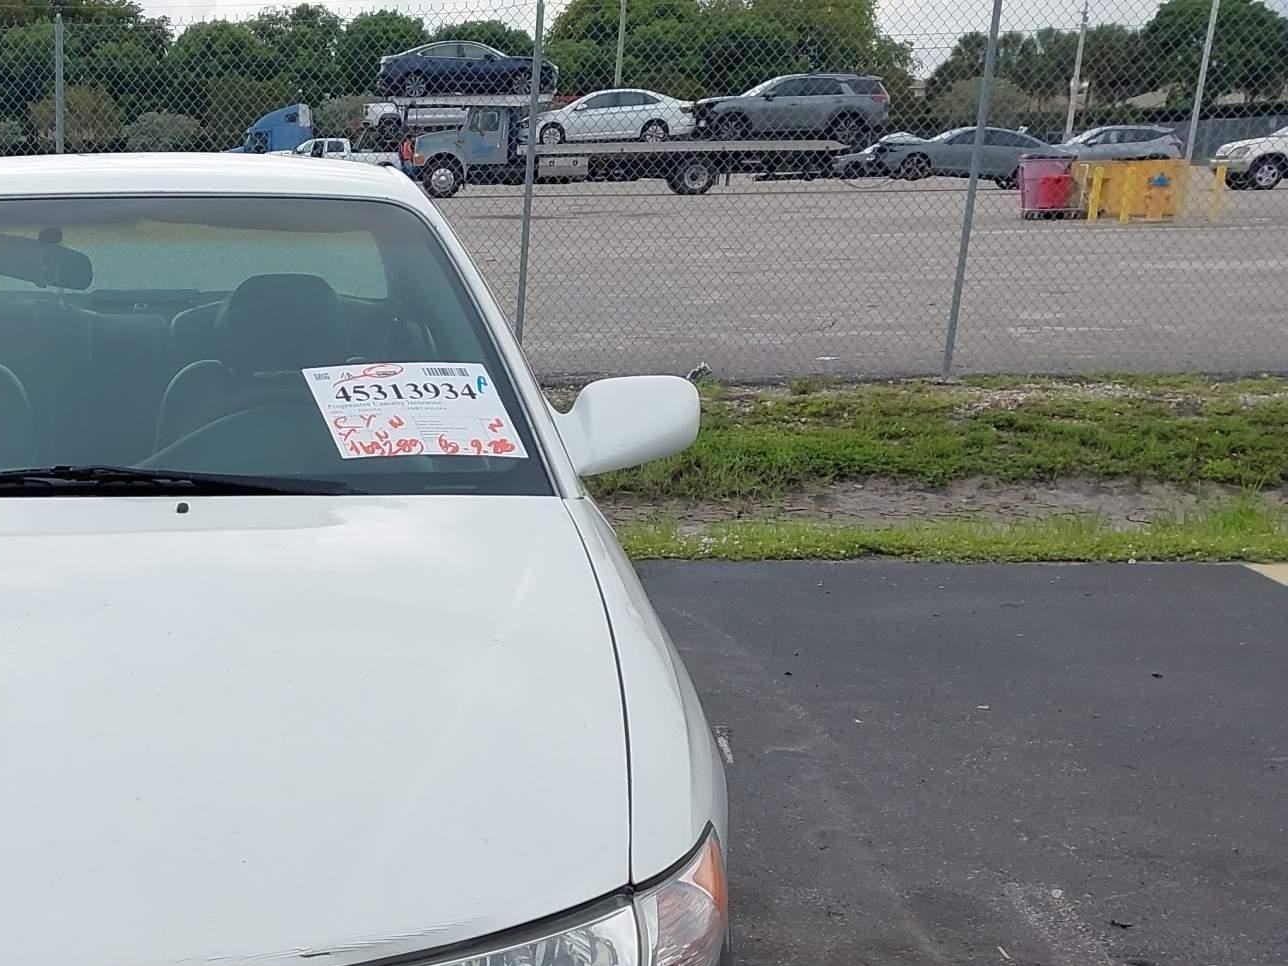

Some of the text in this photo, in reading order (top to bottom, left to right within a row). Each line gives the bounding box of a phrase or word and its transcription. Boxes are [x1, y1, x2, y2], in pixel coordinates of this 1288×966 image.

[335, 382, 477, 402] 45313934
[328, 402, 371, 411] Progressive
[373, 400, 404, 408] Casualty
